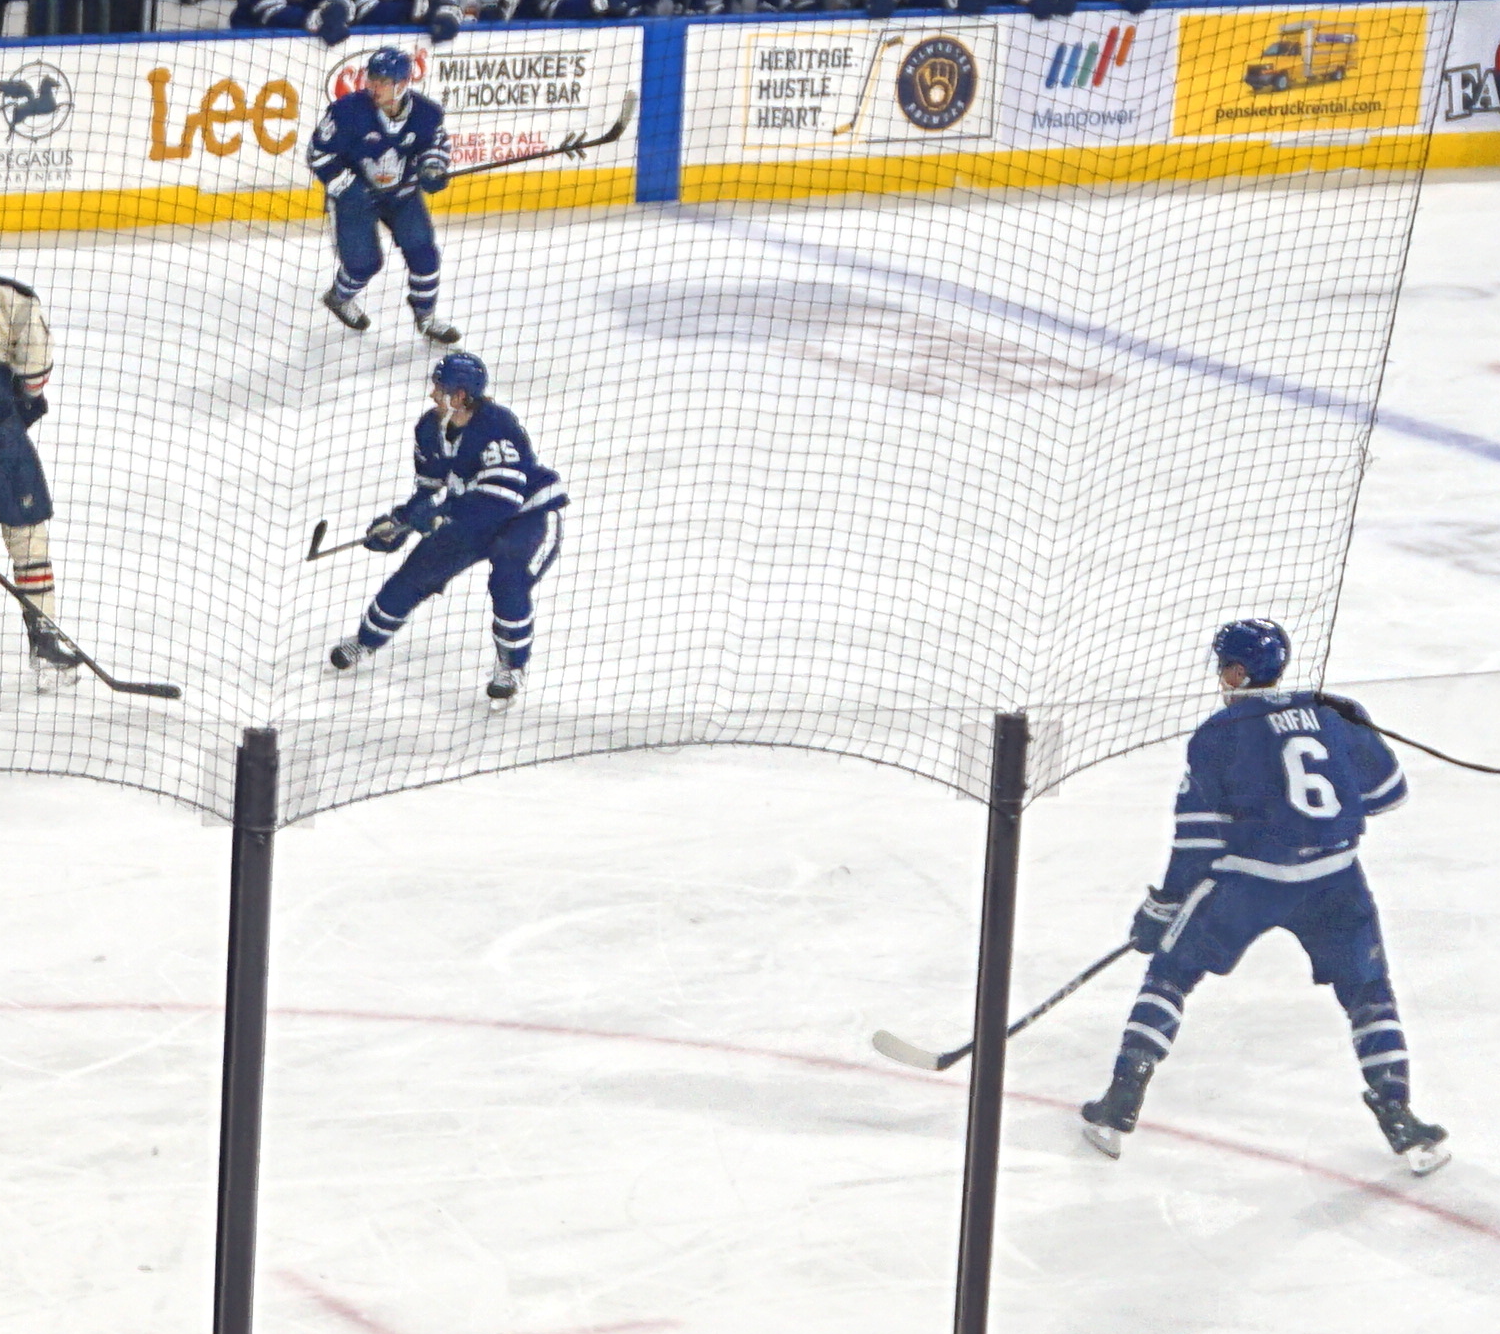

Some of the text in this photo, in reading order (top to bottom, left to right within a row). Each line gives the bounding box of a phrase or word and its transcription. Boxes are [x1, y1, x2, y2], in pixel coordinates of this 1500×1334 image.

[438, 55, 587, 83] MILWAUKEE'S
[760, 46, 858, 72] HERITAGE.
[441, 81, 581, 107] #1 HOCKEY BAR
[757, 76, 837, 100] HUSTLE.
[147, 67, 300, 161] Lee
[756, 105, 826, 129] HEART.
[1031, 105, 1137, 131] Manpower
[1214, 99, 1382, 123] pensketruckrental.com
[490, 132, 512, 147] TO
[516, 130, 545, 145] ALL
[1265, 708, 1322, 736] RIFAI
[1281, 736, 1343, 820] 6
